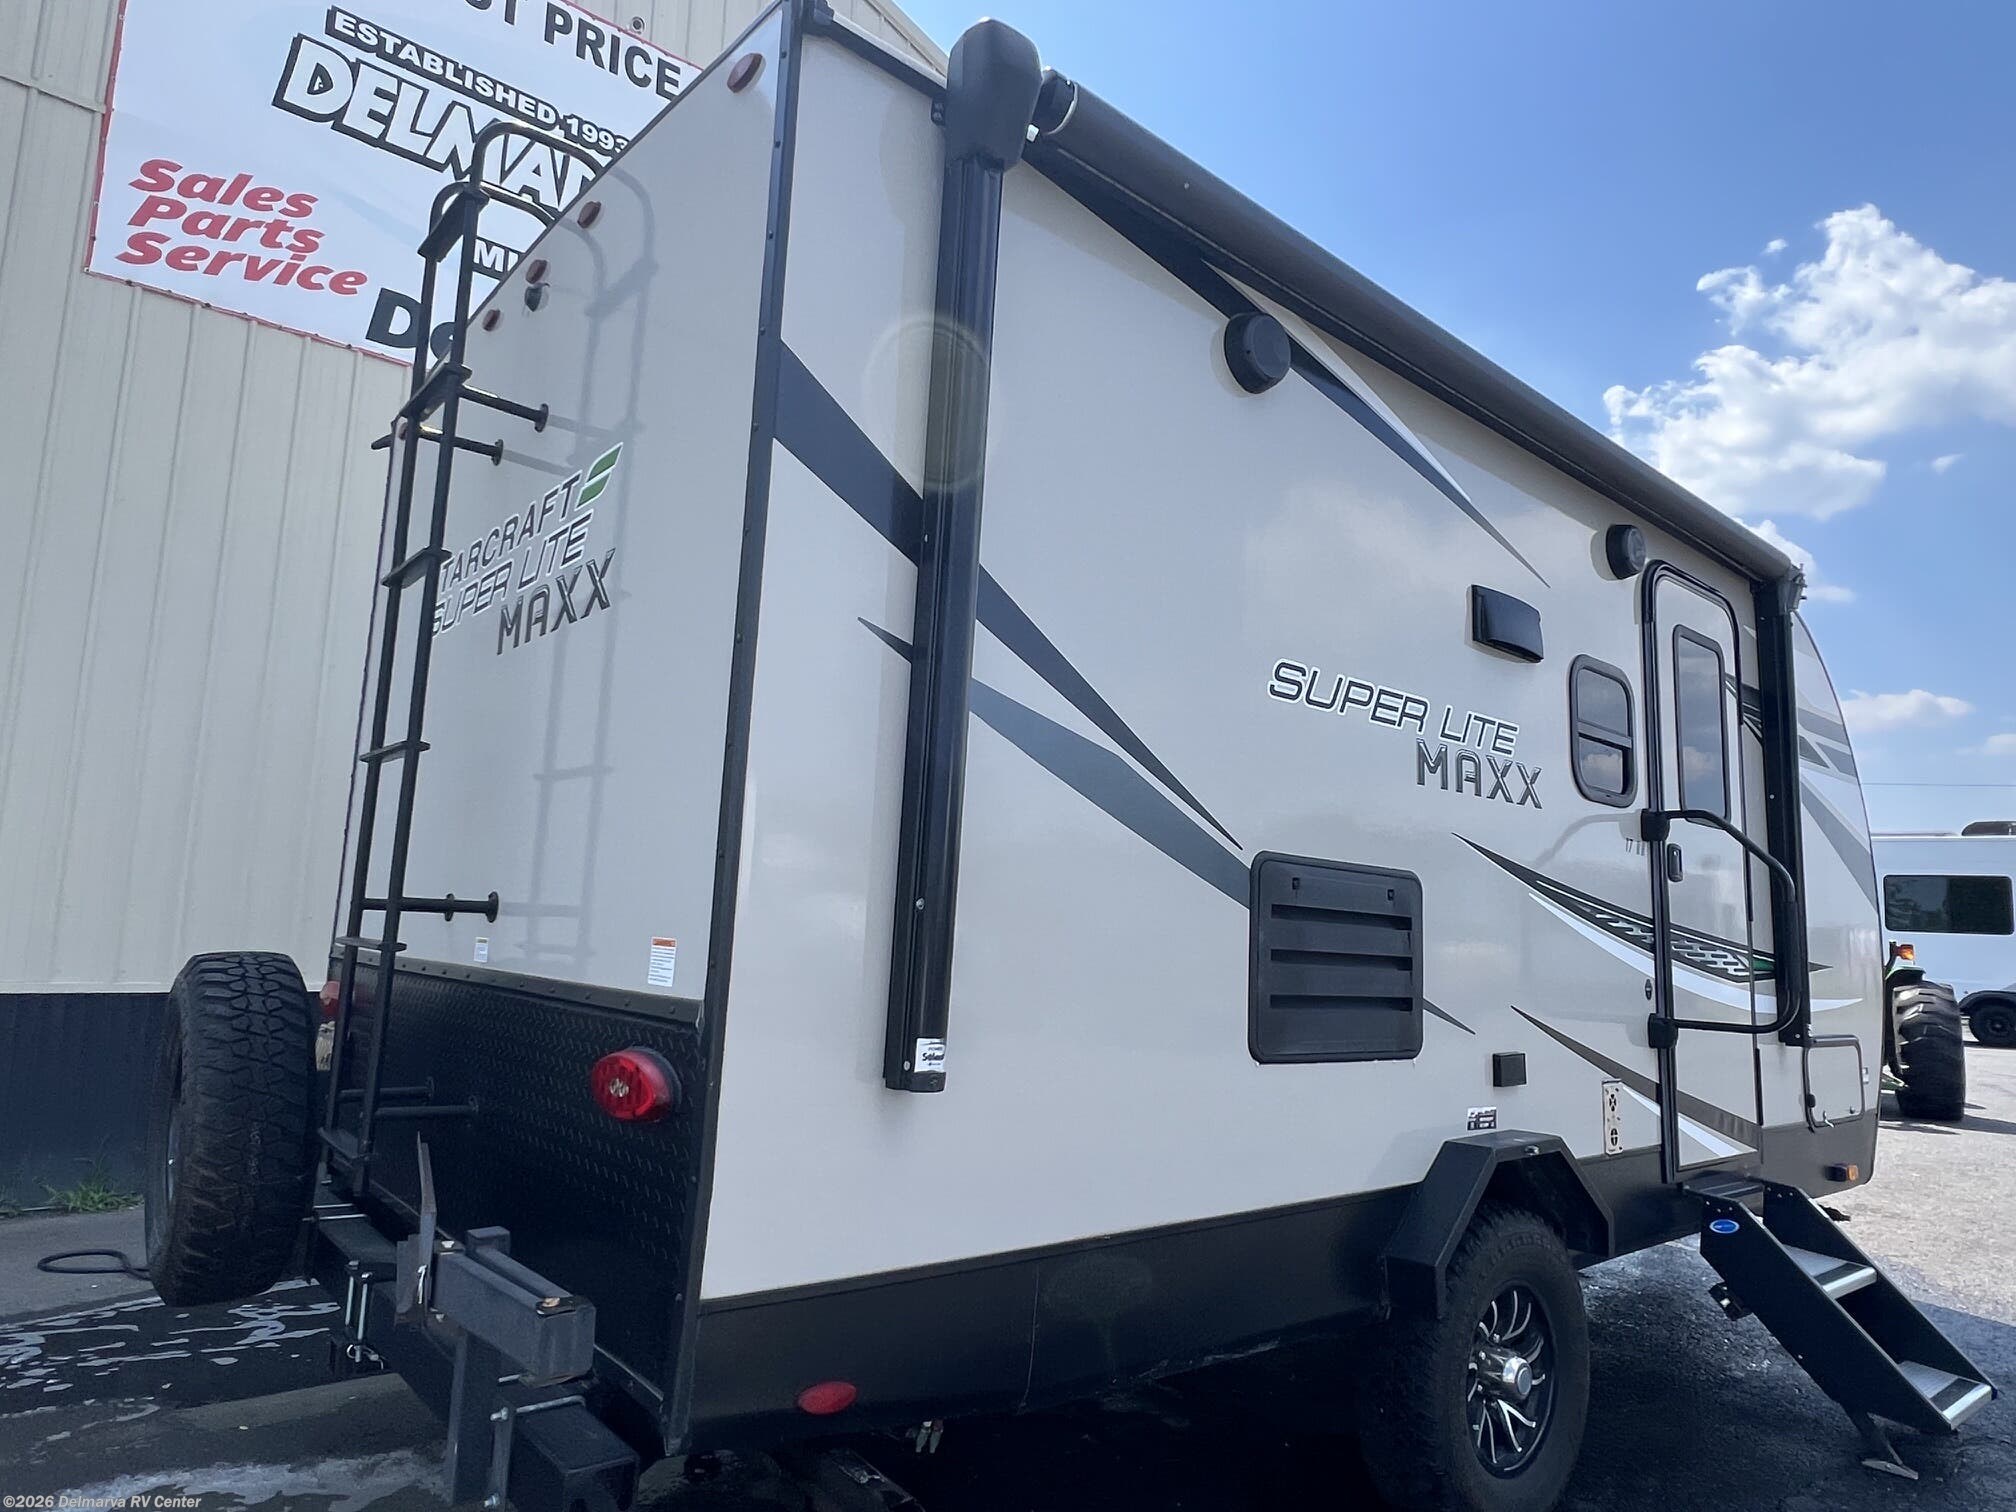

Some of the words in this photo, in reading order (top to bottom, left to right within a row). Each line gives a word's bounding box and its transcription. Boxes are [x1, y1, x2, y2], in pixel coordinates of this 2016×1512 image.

[331, 9, 559, 127] ESTABLISHED
[544, 2, 682, 101] PRICE
[127, 194, 326, 254] Parts
[128, 158, 320, 219] Sales
[115, 231, 368, 295] Service
[517, 509, 594, 591] LITE
[496, 548, 617, 656] MAXX
[1267, 658, 1430, 734] SUPER
[1438, 705, 1520, 756] LITE
[1415, 737, 1544, 810] MAXX
